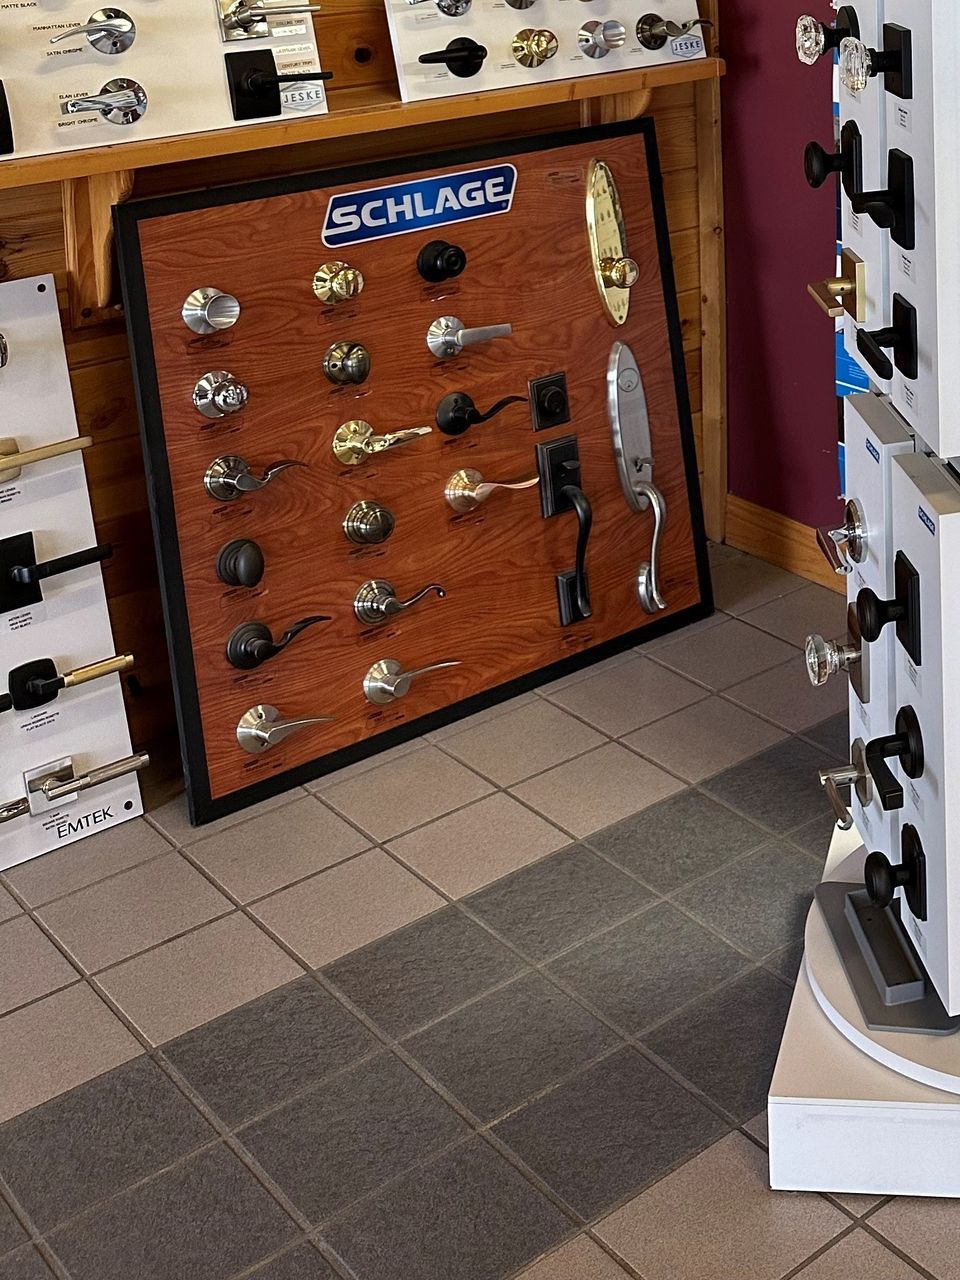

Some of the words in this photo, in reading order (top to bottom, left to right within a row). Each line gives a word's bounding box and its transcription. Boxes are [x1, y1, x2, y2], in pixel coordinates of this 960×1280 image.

[674, 40, 701, 51] JESKE
[284, 90, 321, 104] JESKE
[324, 177, 511, 237] SCHLAGE
[57, 806, 114, 838] EMTEK
